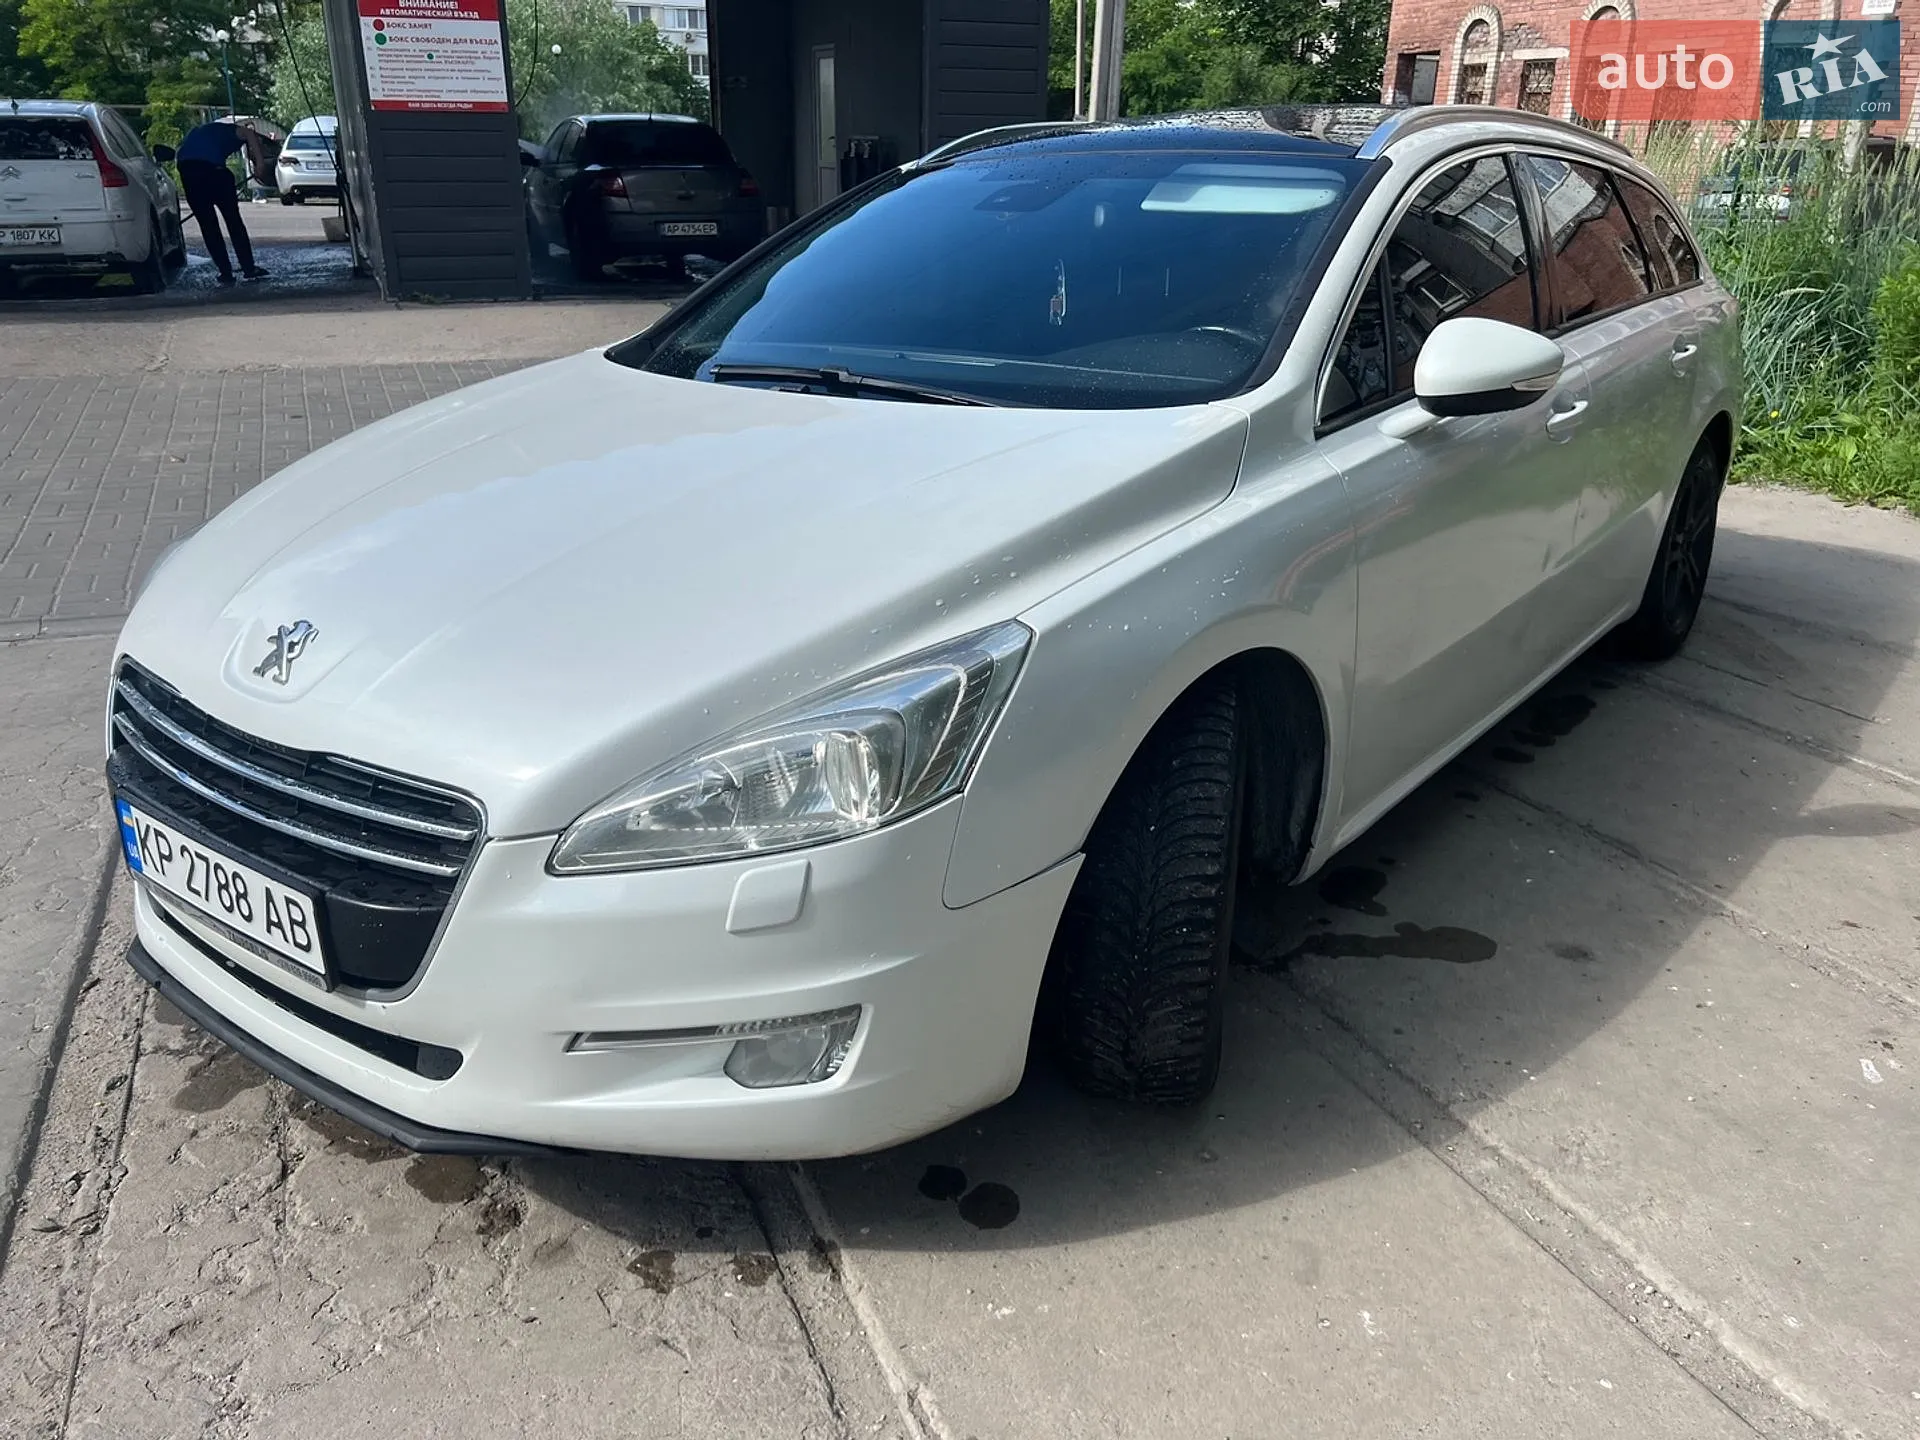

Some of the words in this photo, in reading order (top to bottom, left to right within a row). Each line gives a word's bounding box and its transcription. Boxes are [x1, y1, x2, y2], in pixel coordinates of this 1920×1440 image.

[399, 0, 459, 9] ВНИМАНИЕ!
[380, 8, 454, 18] АВТОМАТИЧЕСКИЙ
[454, 9, 480, 19] ВЪЕЗД
[410, 37, 453, 45] СВОБОДЕН
[469, 38, 499, 46] ВЪЕЗДА
[10, 230, 36, 241] 1807
[38, 229, 56, 240] KK
[135, 816, 173, 877] KP
[180, 844, 253, 923] 2788
[264, 886, 312, 953] AB
